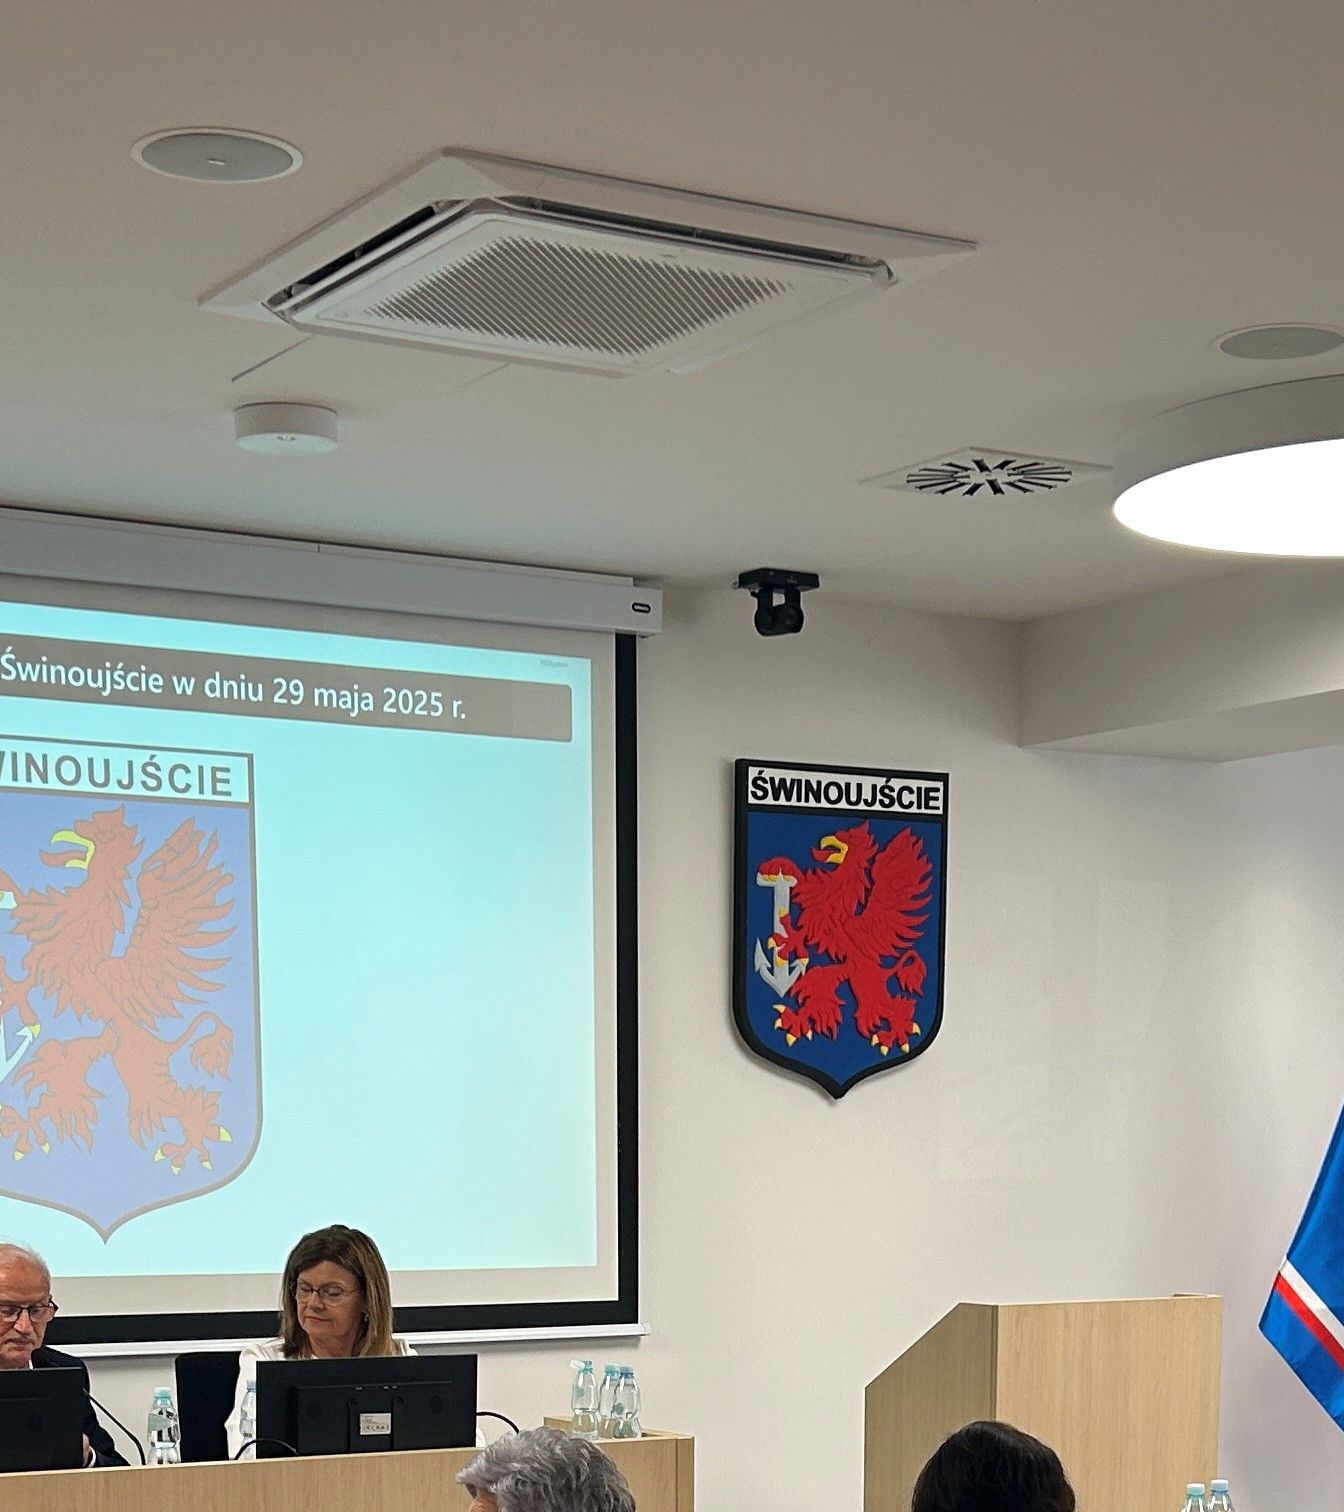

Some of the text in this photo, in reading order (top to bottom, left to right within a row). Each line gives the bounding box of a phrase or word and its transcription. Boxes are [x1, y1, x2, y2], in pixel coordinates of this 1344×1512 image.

[0, 646, 164, 695] Świnoujście
[173, 675, 196, 696] w
[204, 671, 264, 702] dniu
[272, 677, 305, 706] 29
[313, 686, 374, 717] maja
[382, 688, 444, 718] 2025
[452, 696, 467, 720] r.
[750, 769, 941, 811] ŚWINOUJŚCIE
